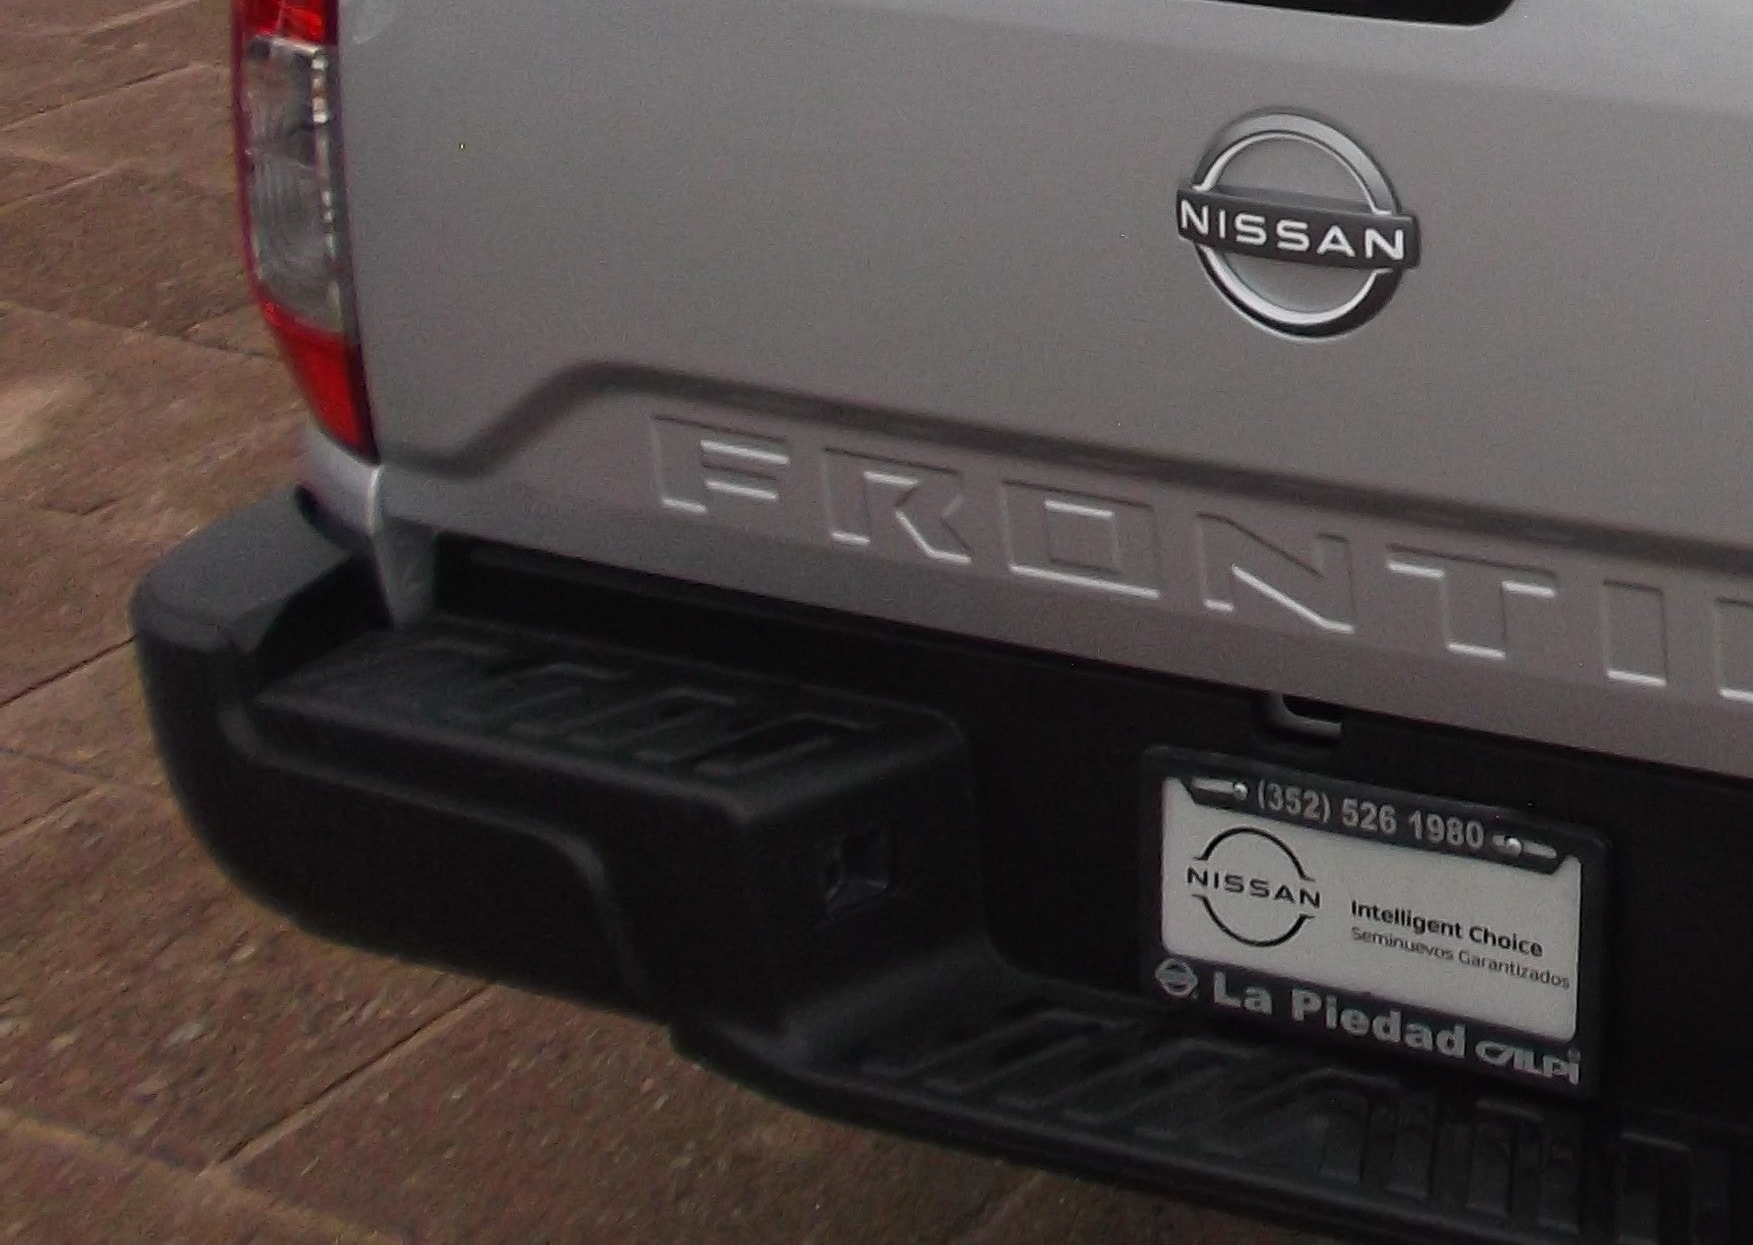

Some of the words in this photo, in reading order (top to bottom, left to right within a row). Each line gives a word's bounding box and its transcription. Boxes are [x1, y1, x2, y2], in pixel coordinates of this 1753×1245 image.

[1180, 199, 1405, 261] NISSAN
[1256, 779, 1331, 823] (352)
[1342, 798, 1397, 835] 526
[1409, 809, 1484, 850] 1980
[1186, 866, 1321, 910] NISSAN
[1351, 899, 1463, 936] Intelligent
[1469, 925, 1544, 958] Choice
[1351, 926, 1454, 961] Seminuevos
[1458, 949, 1571, 991] Garantizados
[1213, 970, 1273, 1017] La
[1291, 987, 1466, 1059] Piedad
